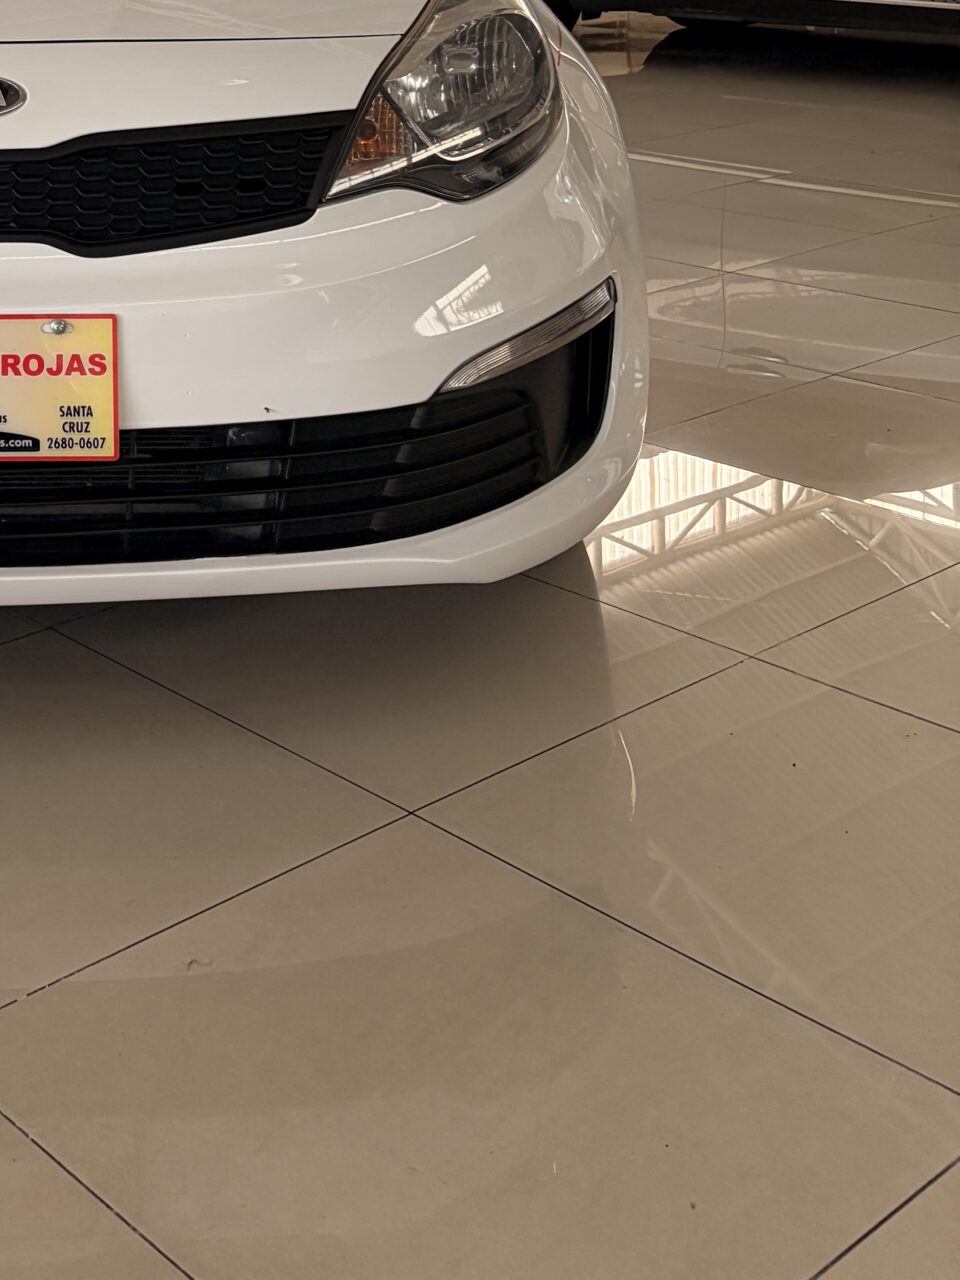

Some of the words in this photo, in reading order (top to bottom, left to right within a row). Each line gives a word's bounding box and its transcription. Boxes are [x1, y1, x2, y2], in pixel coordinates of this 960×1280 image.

[0, 353, 108, 378] ROJAS
[59, 405, 94, 418] SANTA
[62, 421, 91, 434] CRUZ
[47, 437, 106, 450] 2680-0607
